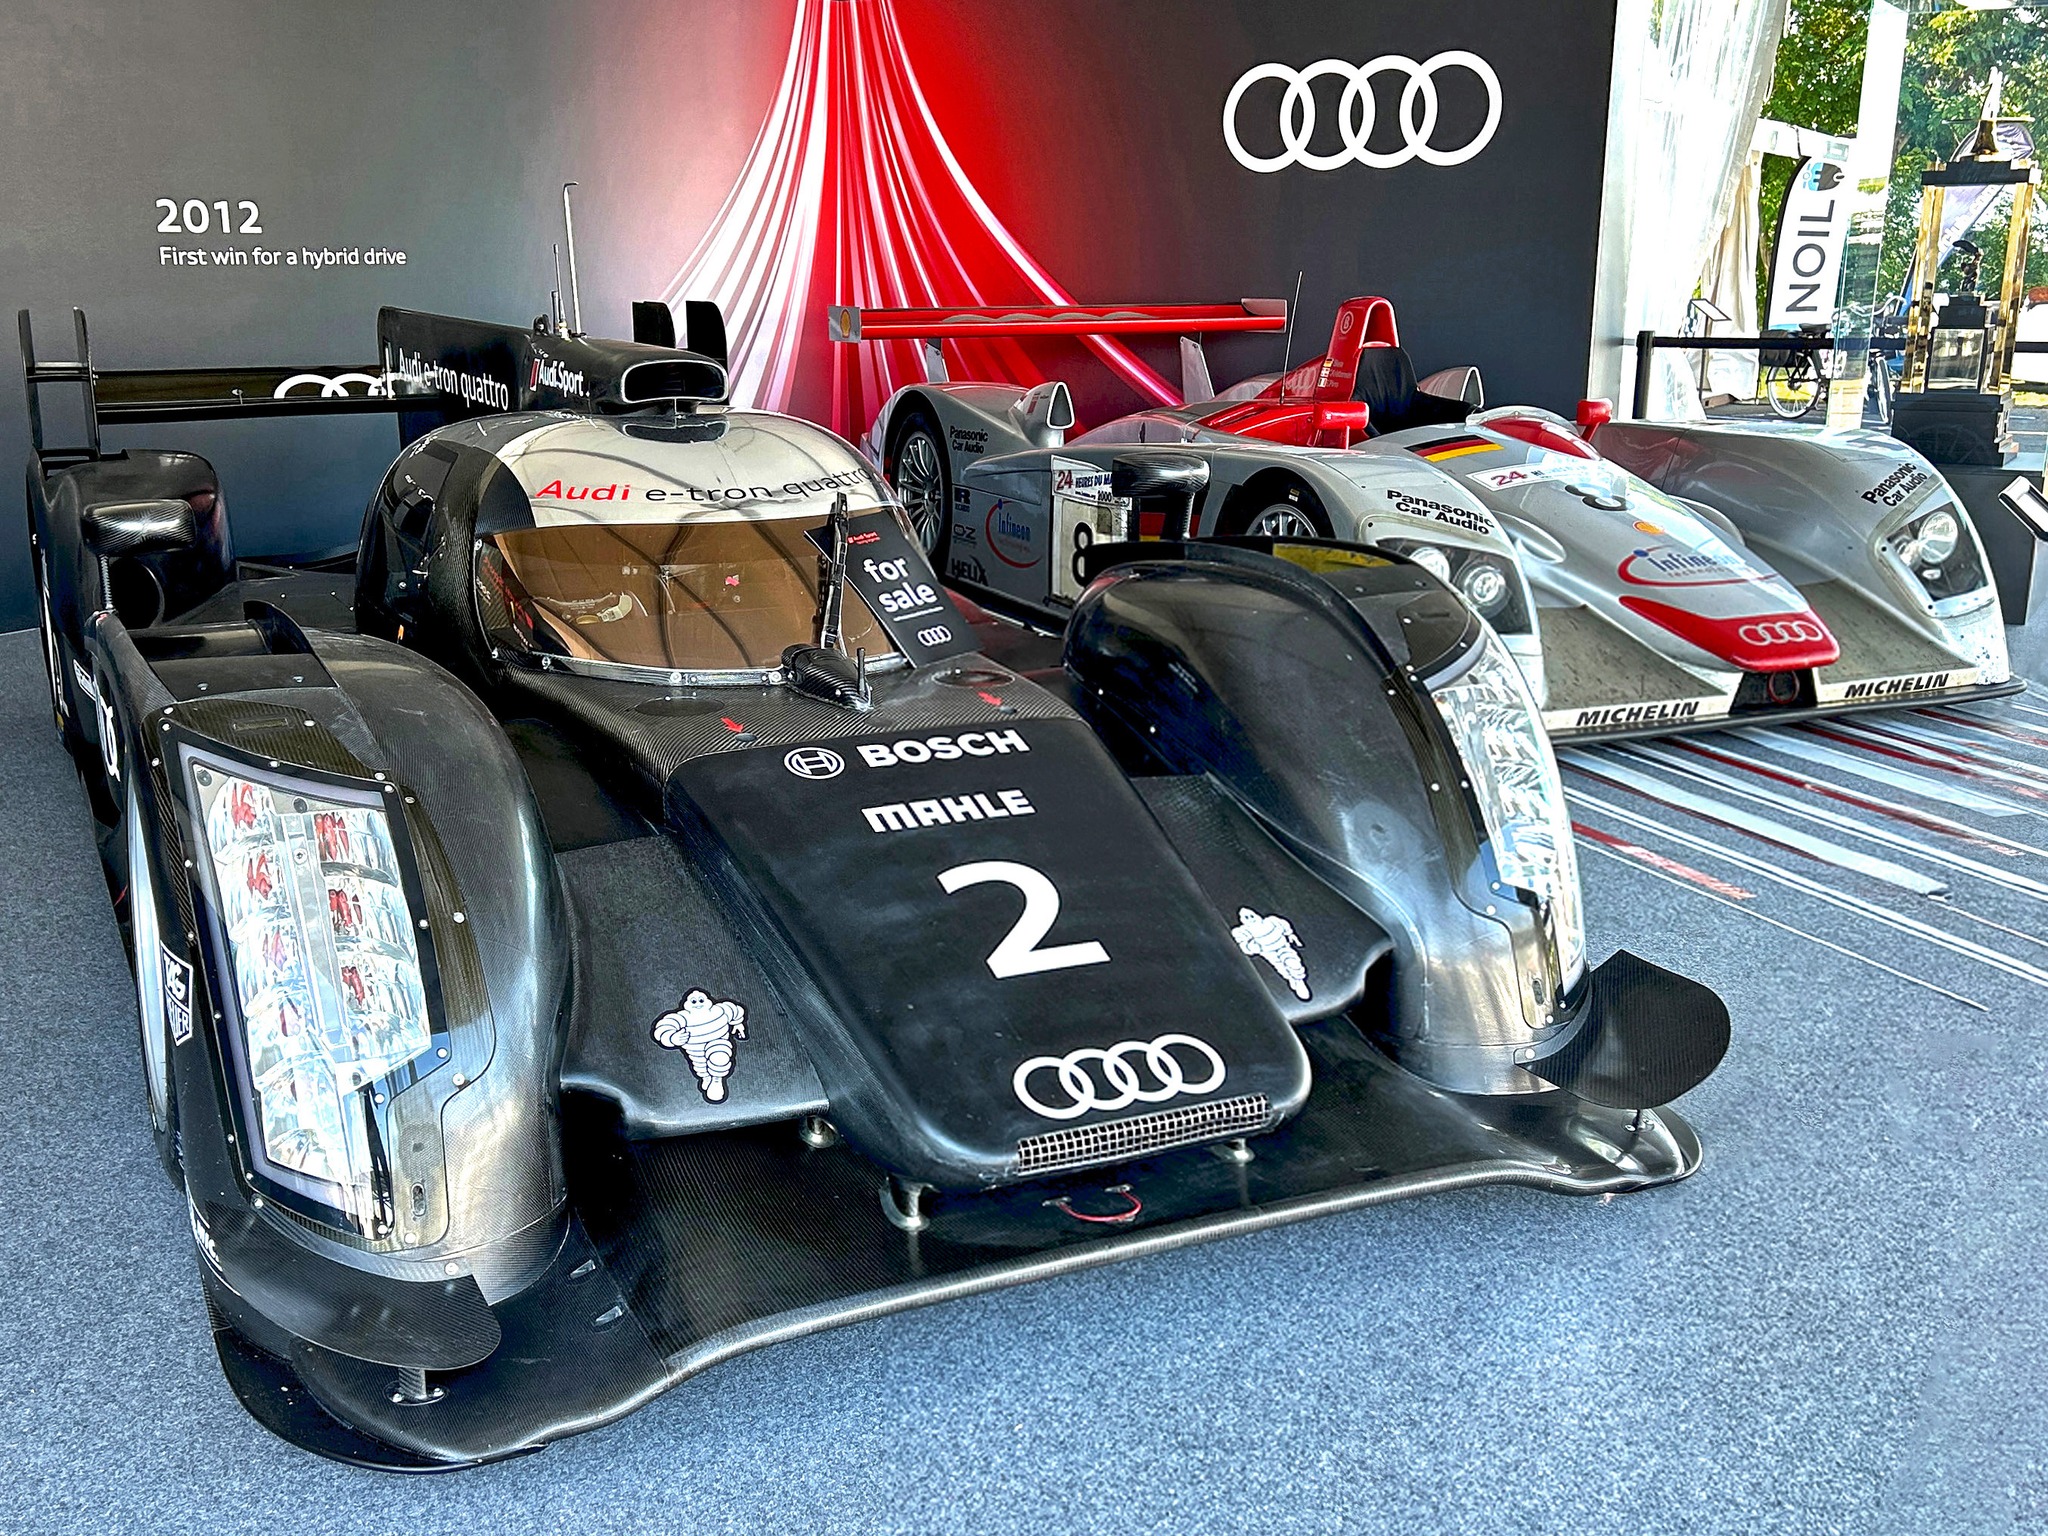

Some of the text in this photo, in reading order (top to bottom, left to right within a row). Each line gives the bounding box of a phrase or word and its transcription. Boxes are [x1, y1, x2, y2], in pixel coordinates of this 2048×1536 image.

[155, 198, 263, 234] 2012
[159, 246, 407, 270] First win for a hybrid drive
[1785, 199, 1835, 312] NOIL
[399, 347, 422, 383] Audi
[460, 372, 509, 411] quattro
[538, 359, 585, 398] Audi Sport
[950, 425, 988, 443] Panasonic
[952, 440, 985, 454] Car Audio
[535, 467, 872, 502] Audi e-tron quattro
[1056, 469, 1073, 491] 24
[1491, 470, 1528, 487] 24
[1861, 462, 1917, 504] Panasonic
[1882, 472, 1928, 507] Car Audio
[1386, 489, 1495, 528] Panasonic
[1395, 502, 1490, 535] Car Audio
[863, 558, 909, 583] for
[951, 554, 989, 587] HELIX
[1072, 522, 1094, 589] 8
[878, 582, 938, 612] sale
[1844, 673, 1949, 699] MICHELIN
[1575, 702, 1699, 727] MICHELIN
[856, 729, 1031, 768] BOSCH
[861, 789, 1036, 833] MAHLE
[936, 859, 1111, 979] 2
